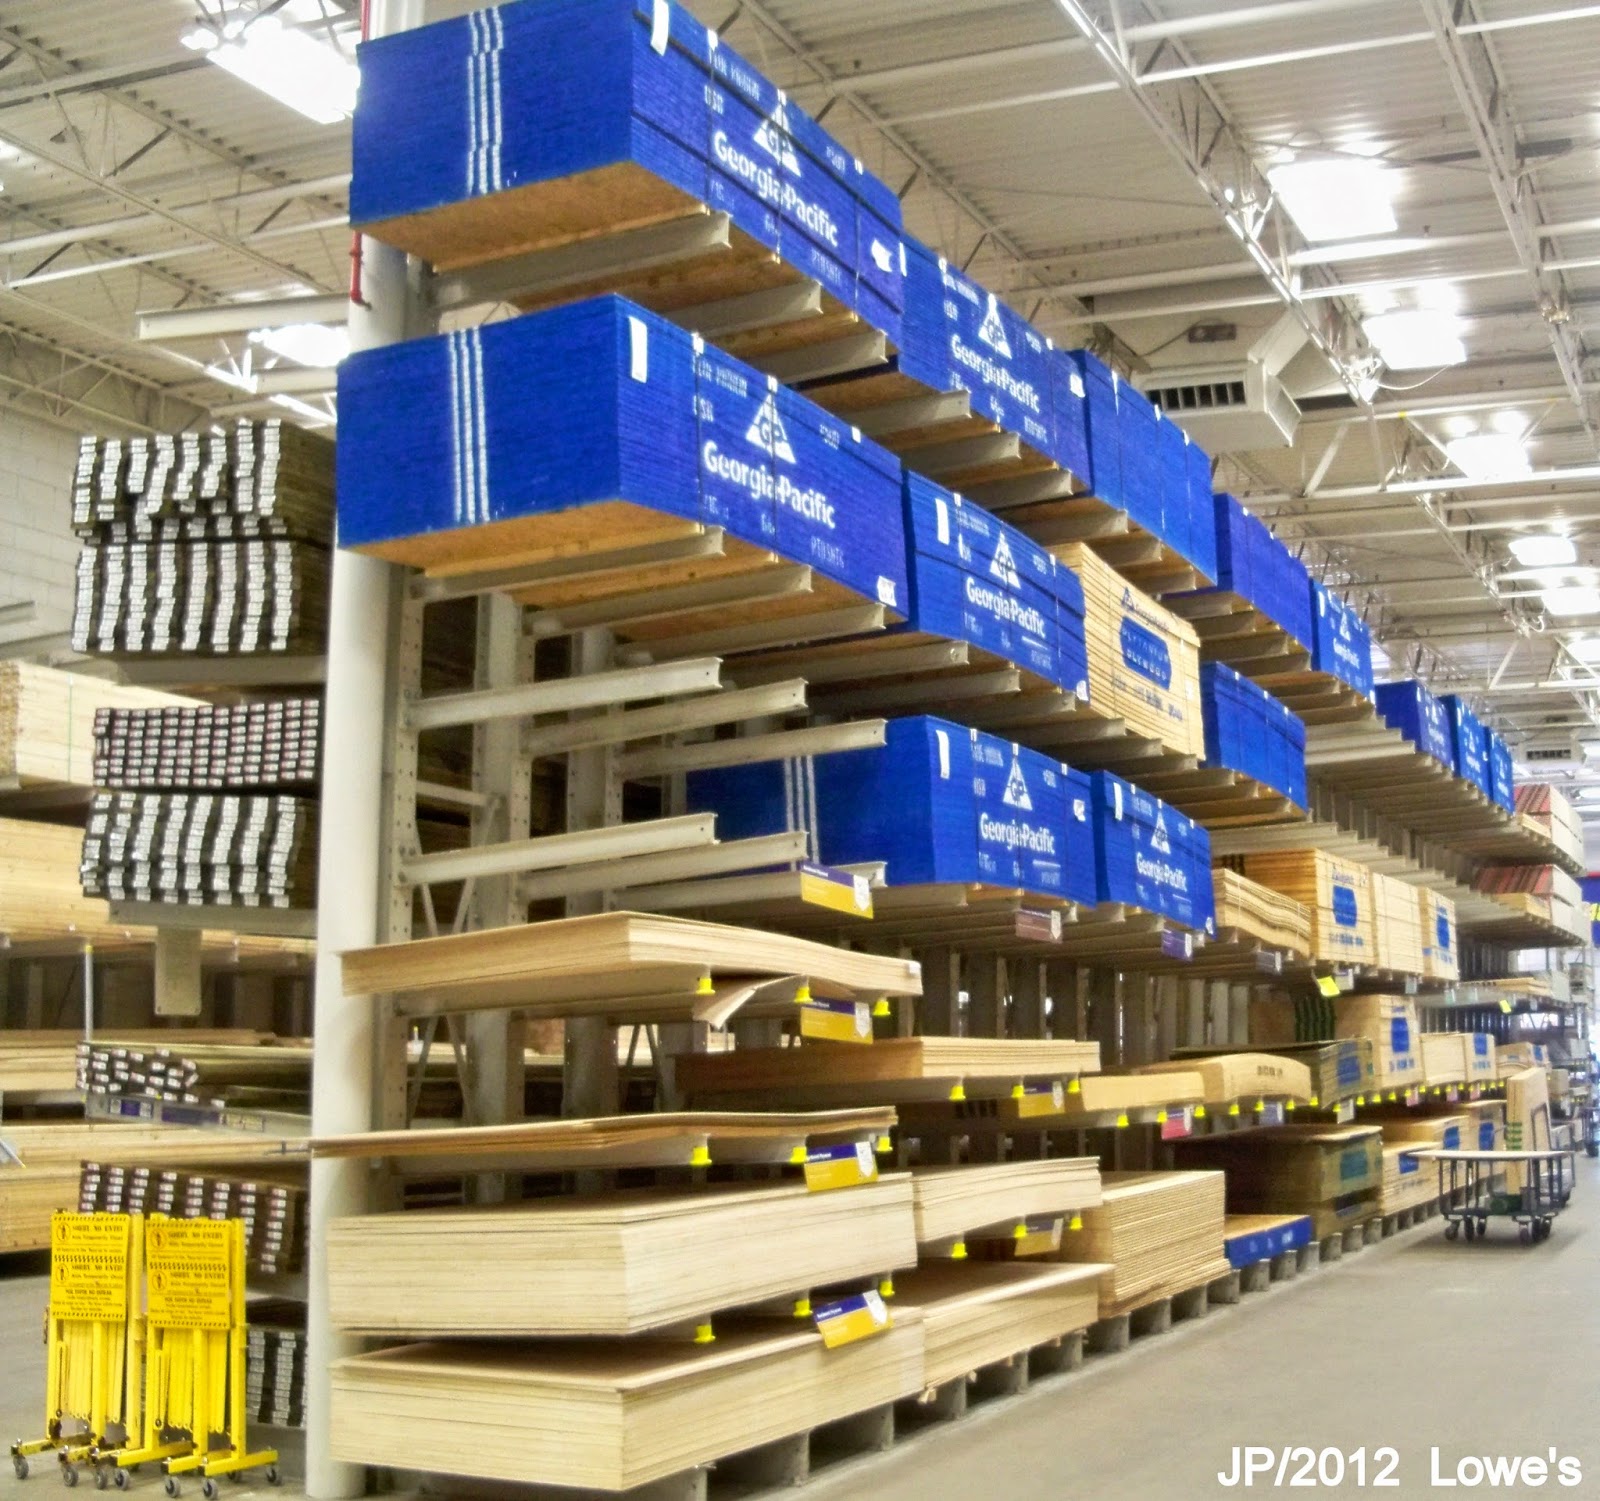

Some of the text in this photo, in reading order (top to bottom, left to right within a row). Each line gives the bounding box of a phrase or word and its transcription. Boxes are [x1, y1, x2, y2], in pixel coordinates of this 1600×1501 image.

[713, 130, 839, 248] Georgia-Pacific
[951, 333, 1040, 414] Georgia-Pacific
[703, 440, 836, 529] Georgia-Pacific
[966, 576, 1046, 639] Georgia-Pacific
[980, 812, 1055, 855] Georgia-Pacific
